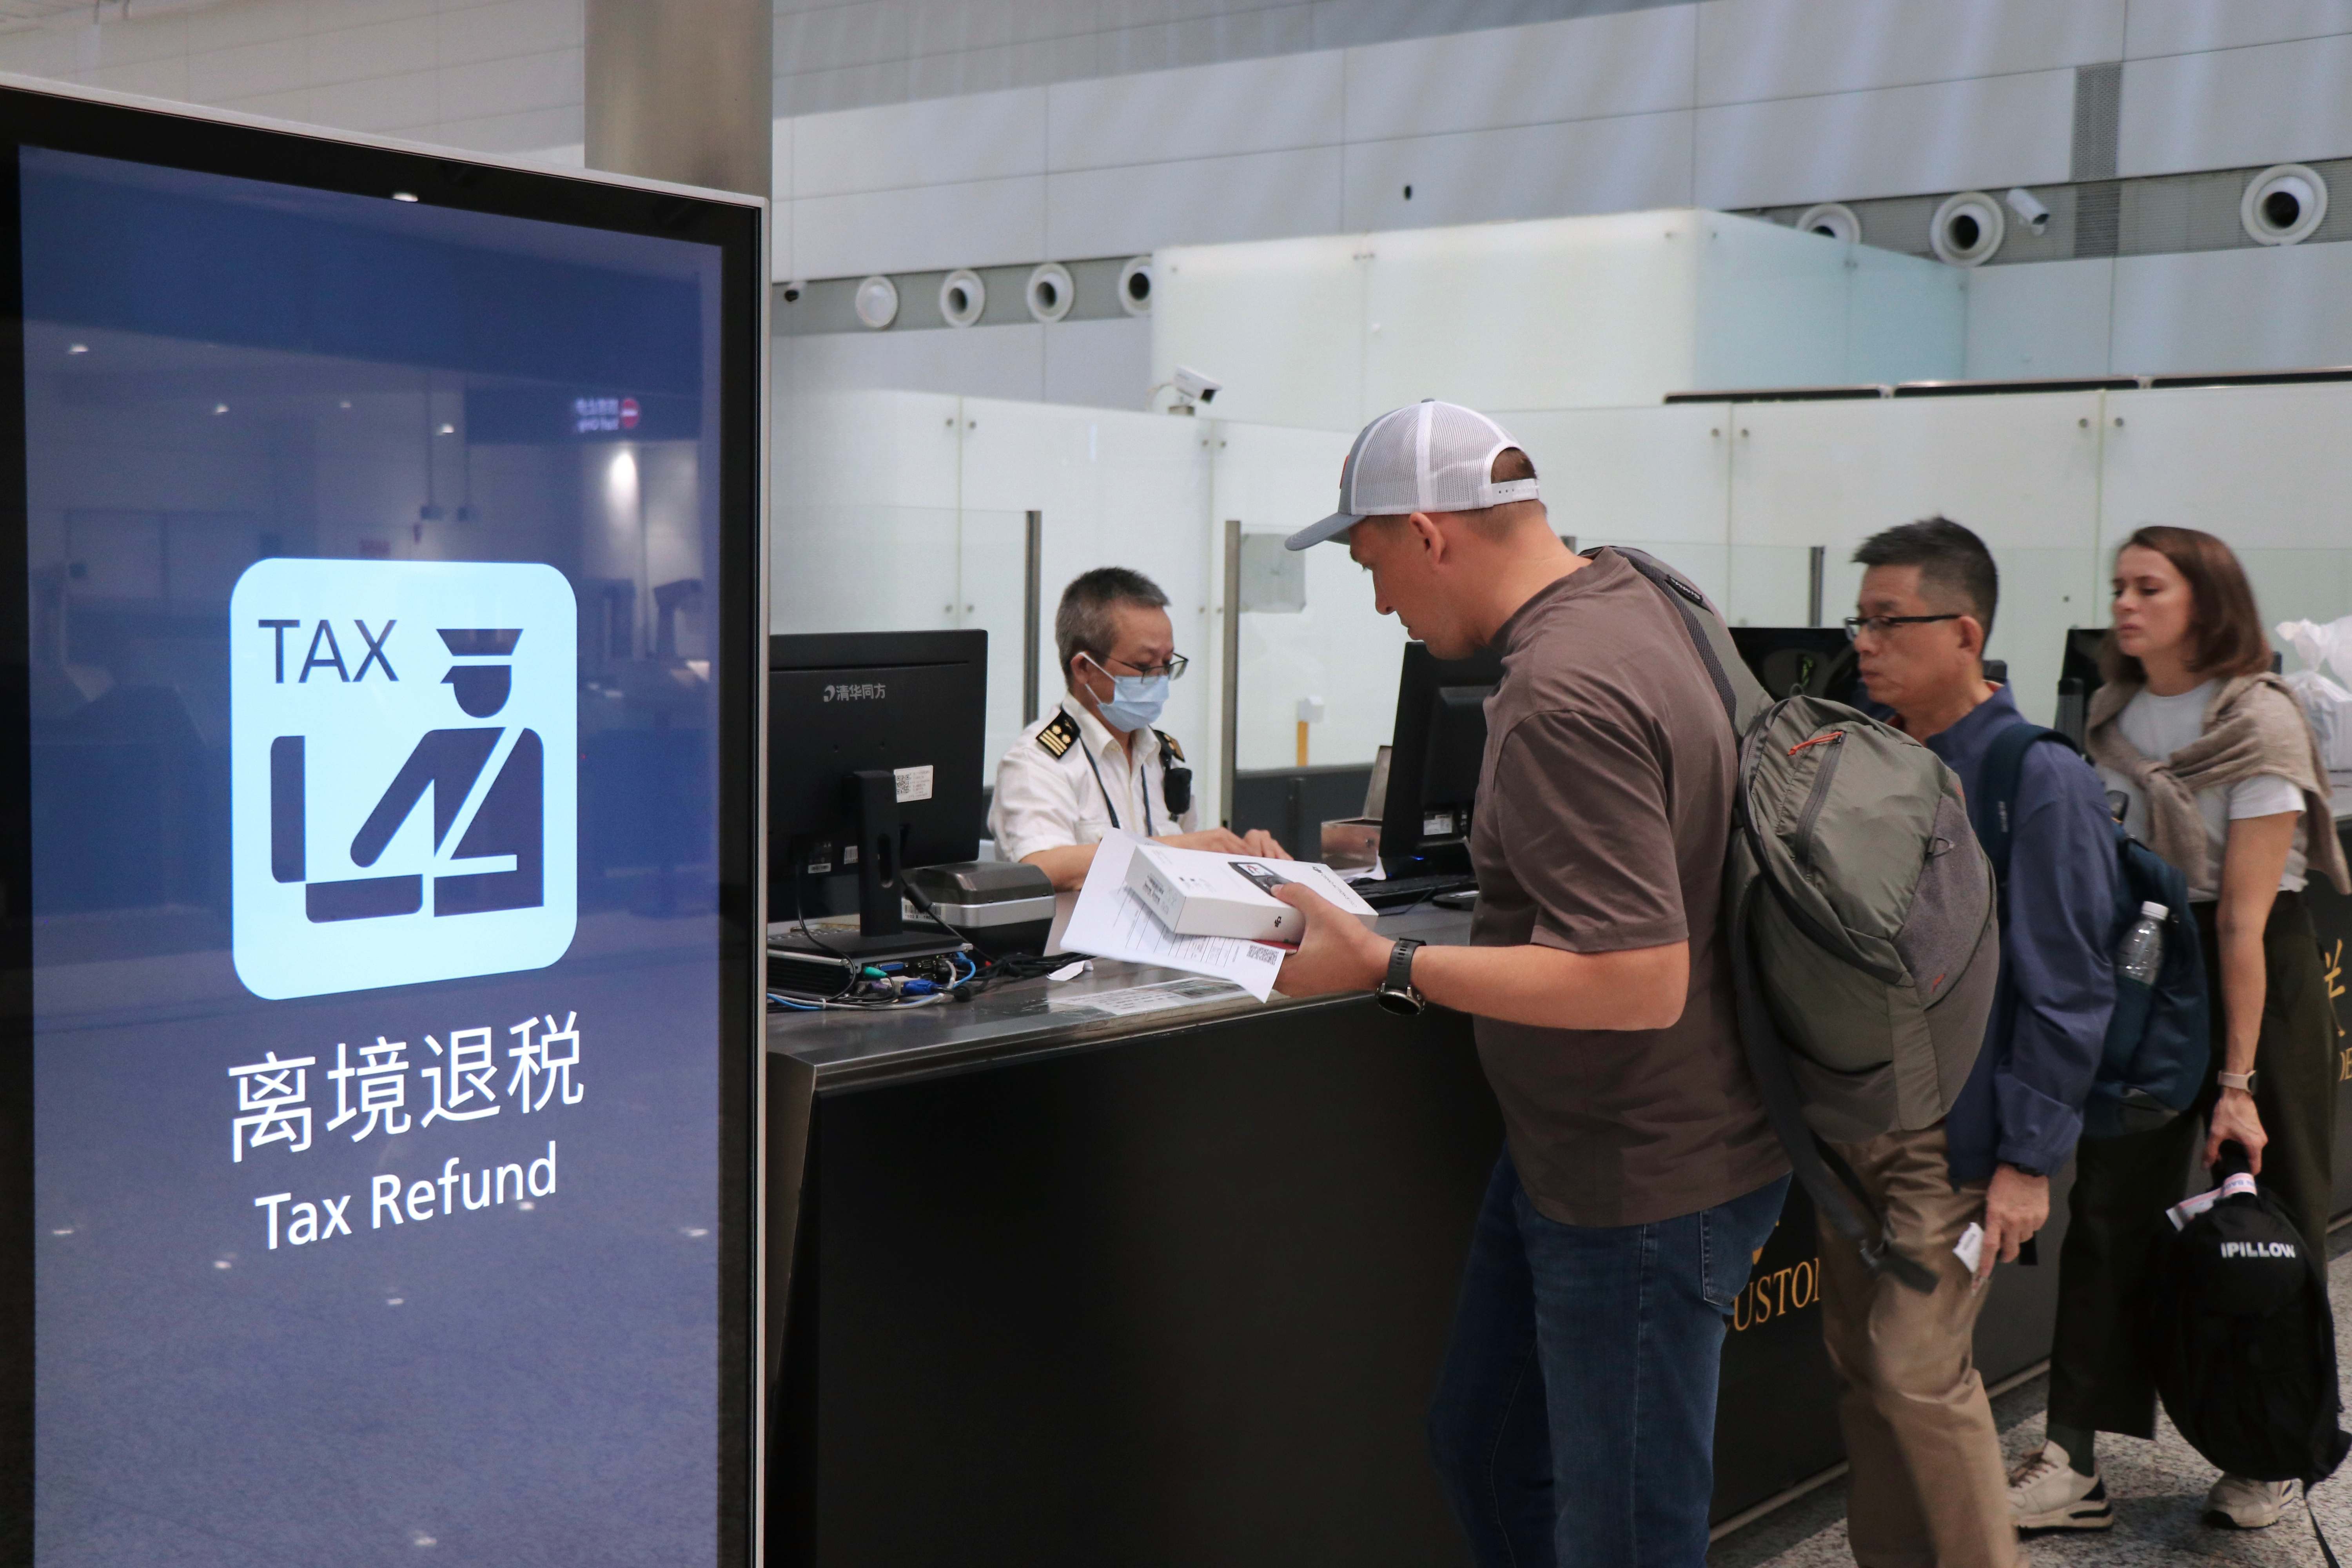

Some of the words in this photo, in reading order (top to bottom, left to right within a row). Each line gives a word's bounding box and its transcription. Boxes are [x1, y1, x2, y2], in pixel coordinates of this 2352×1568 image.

[258, 619, 399, 684] TAX
[836, 683, 886, 701] 清华同方
[228, 1011, 584, 1163] 离境退税
[255, 1192, 352, 1250] Tax
[372, 1141, 556, 1230] Refund
[1726, 1258, 1820, 1331] USTO
